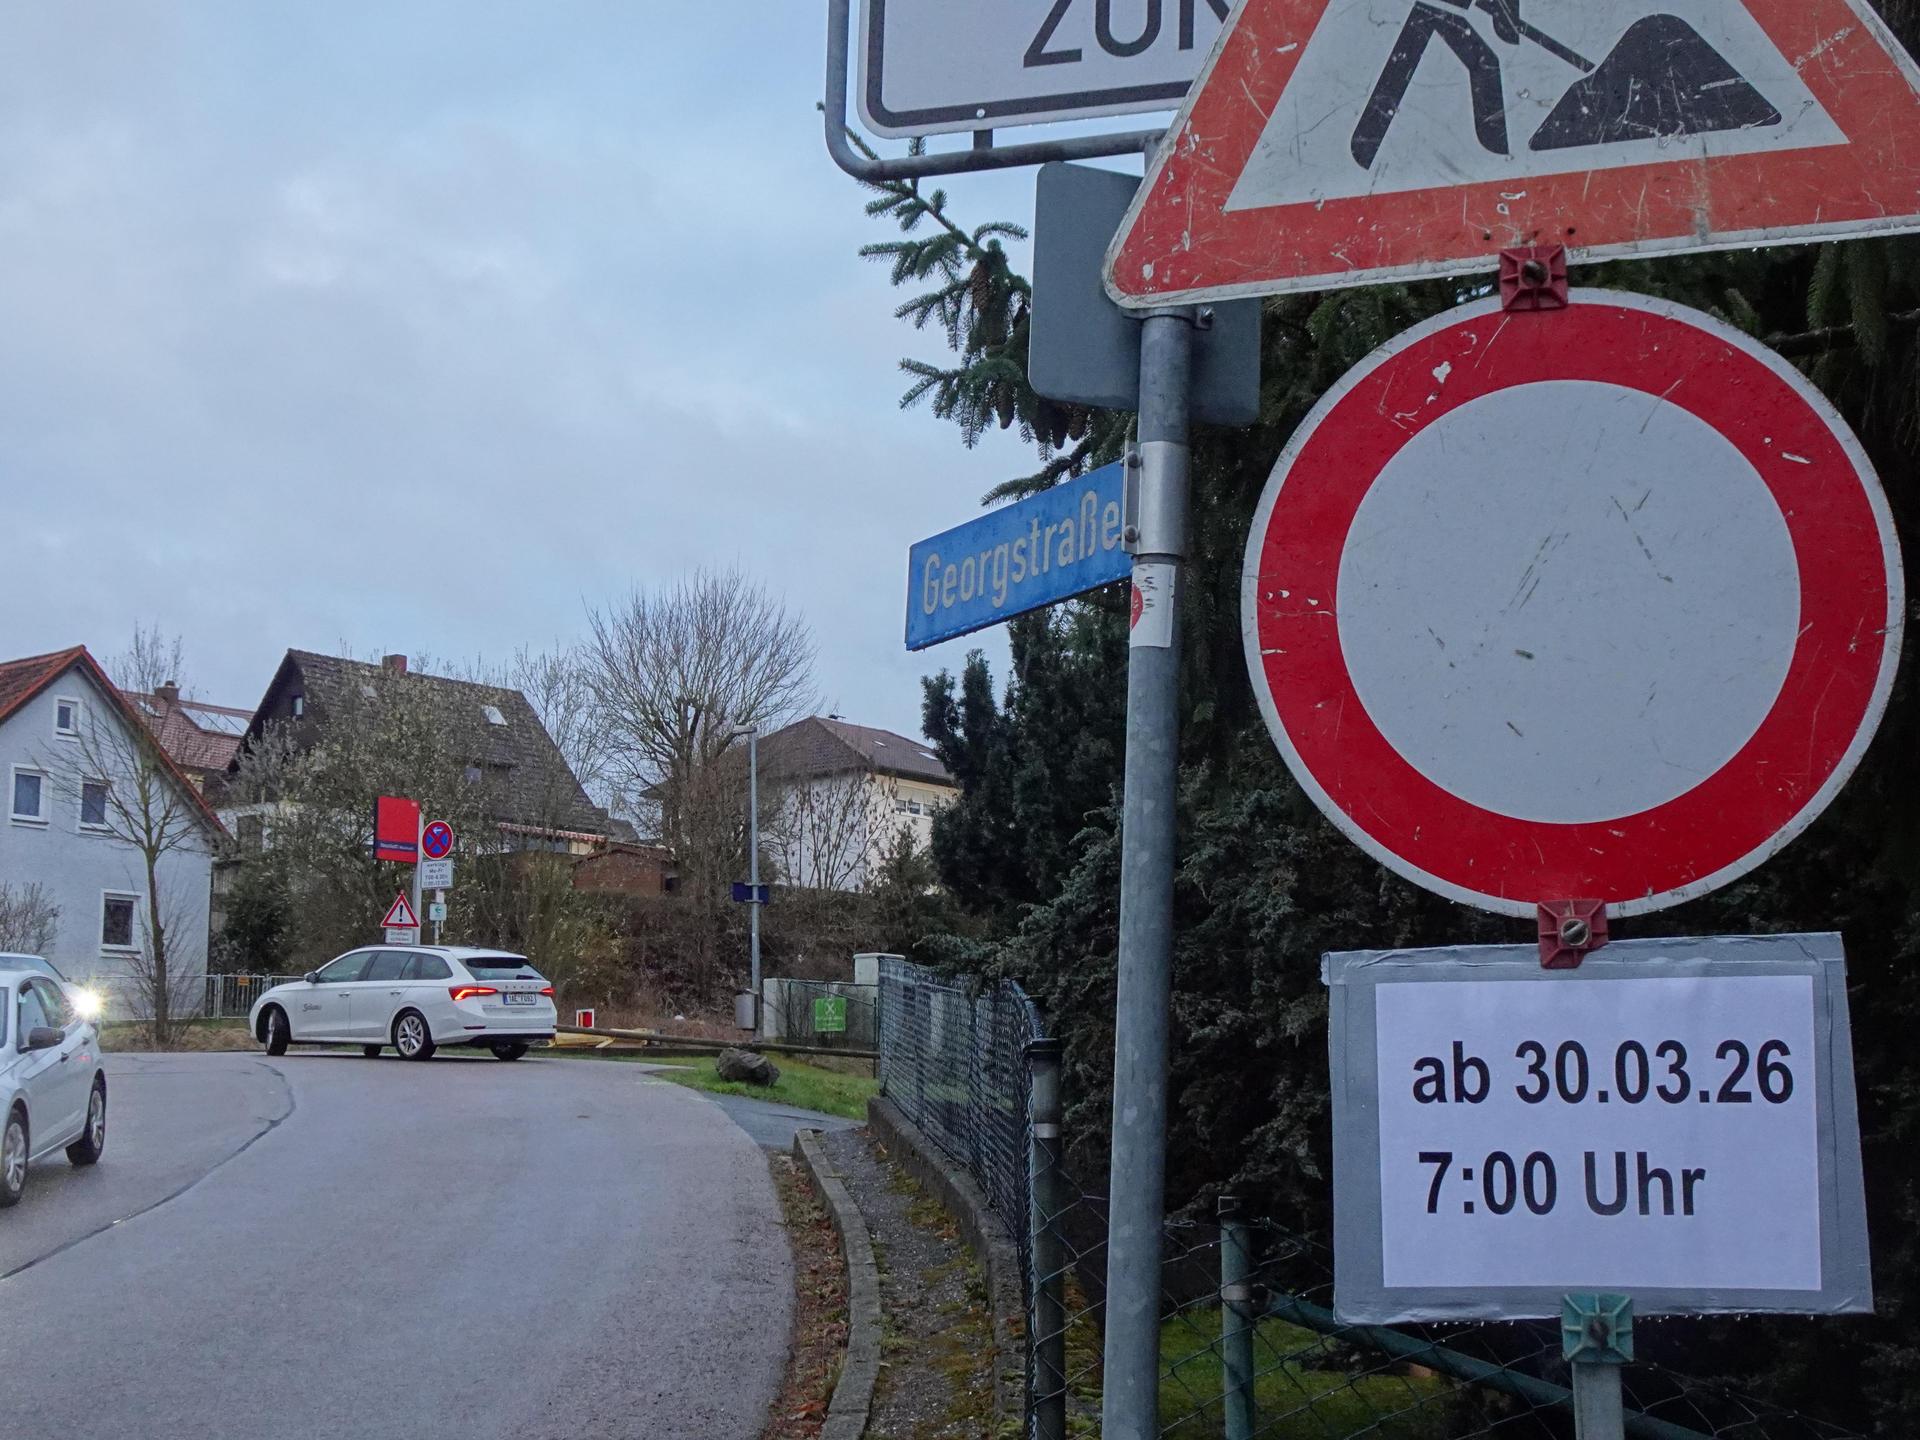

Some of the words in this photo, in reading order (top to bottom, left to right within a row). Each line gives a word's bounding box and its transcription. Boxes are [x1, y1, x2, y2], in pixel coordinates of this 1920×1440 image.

[921, 490, 1121, 616] Georgstraße
[1412, 1040, 1491, 1104] ab
[1515, 1039, 1794, 1105] 30.03.26
[1418, 1150, 1557, 1216] 7:00
[1584, 1151, 1706, 1216] Uhr
